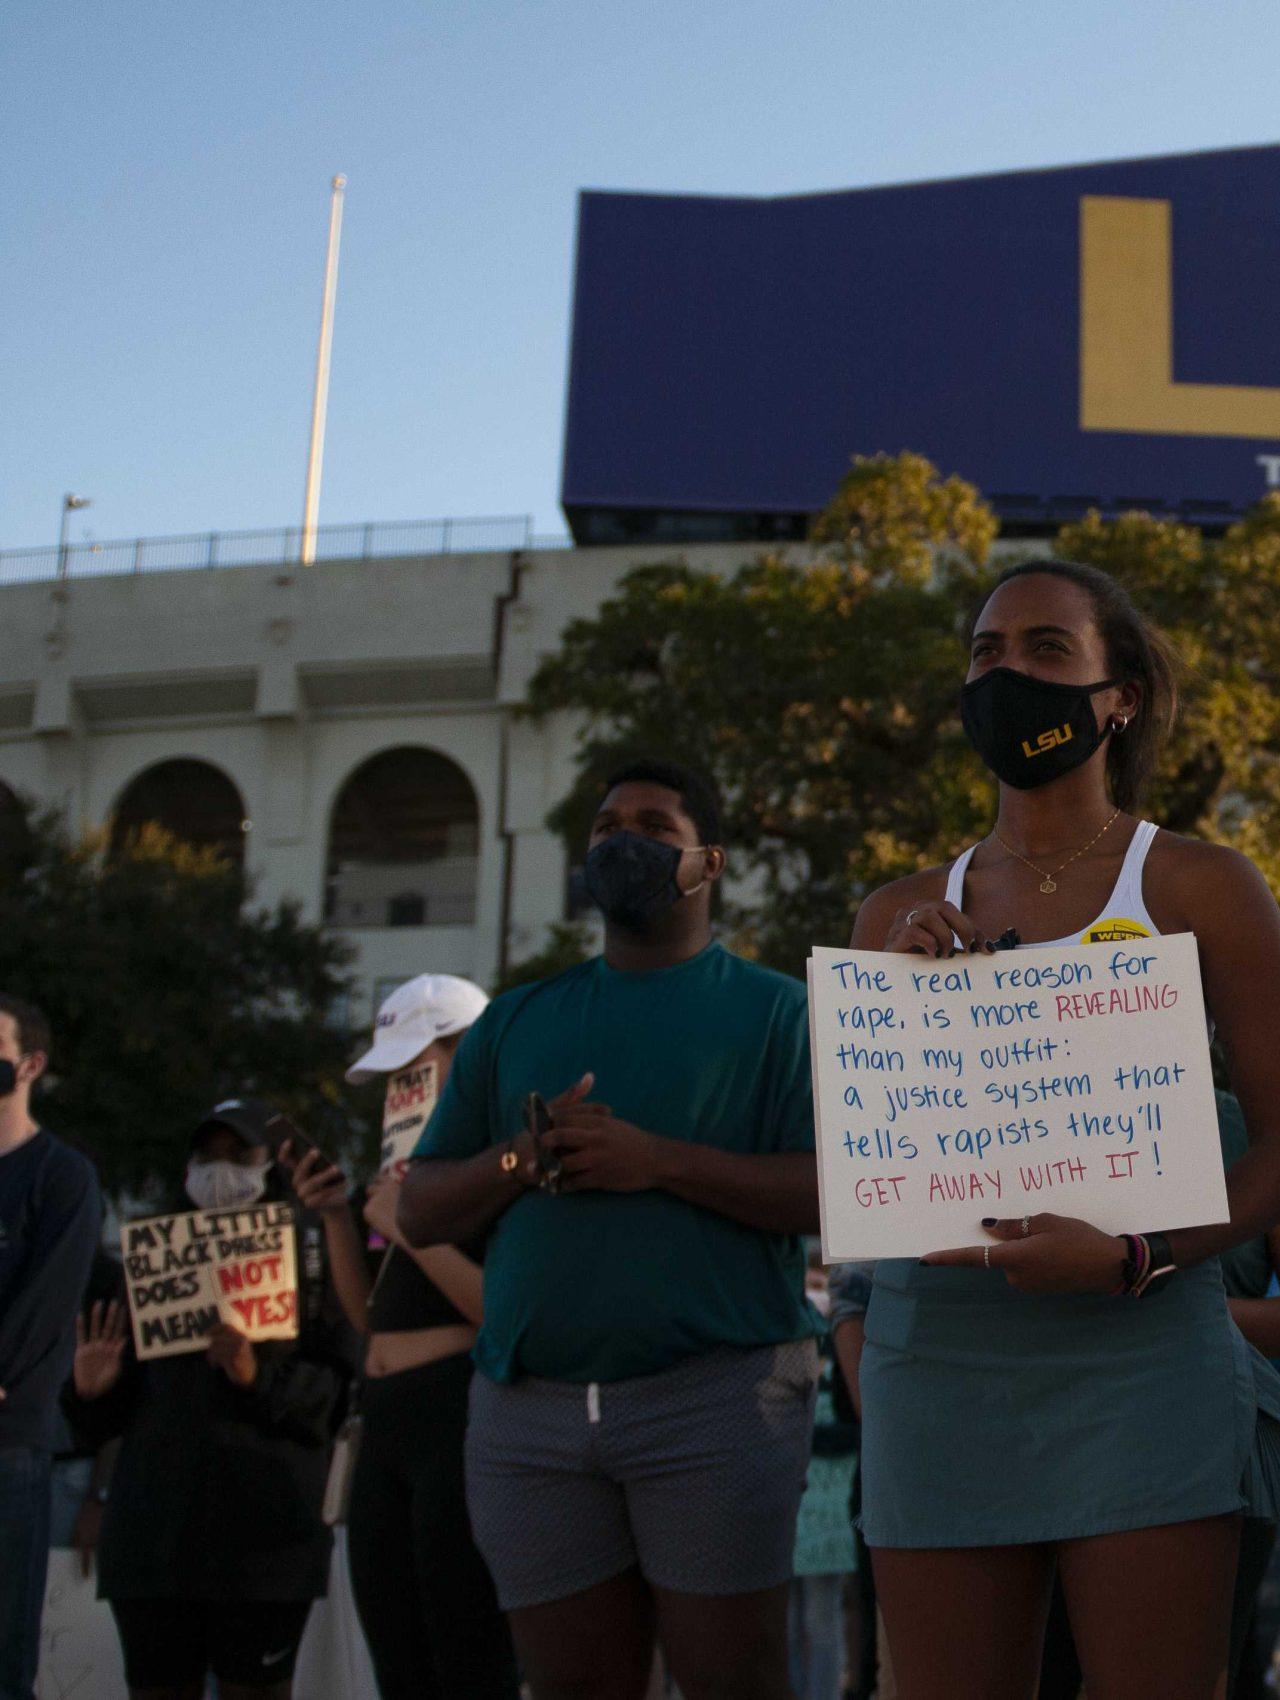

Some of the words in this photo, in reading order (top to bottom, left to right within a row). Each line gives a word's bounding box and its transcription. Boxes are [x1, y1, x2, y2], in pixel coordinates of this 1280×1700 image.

[1022, 722, 1073, 758] LSU
[831, 961, 893, 993] The
[911, 968, 973, 994] real
[994, 961, 1093, 990] reason
[1108, 951, 1159, 980] for
[922, 1004, 952, 1030] is
[970, 1000, 1042, 1027] more
[1055, 983, 1179, 1023] REVEALING
[836, 1042, 905, 1073] than
[923, 1048, 963, 1077] my
[843, 1086, 864, 1111] a
[885, 1083, 968, 1122] justice
[984, 1073, 1093, 1109] system
[1113, 1060, 1187, 1092] that
[842, 1129, 919, 1161] tells
[936, 1117, 1050, 1158] rapists
[1065, 1102, 1163, 1145] they'll
[855, 1176, 907, 1209] GET
[928, 1172, 1002, 1204] AWAY
[1019, 1156, 1088, 1192] WITH
[128, 1219, 176, 1252] MY
[187, 1205, 295, 1240] LITTLE
[127, 1241, 213, 1281] BLACK
[215, 1230, 283, 1258] DRESS
[132, 1271, 200, 1310] DOES
[217, 1256, 282, 1296] NOT
[140, 1303, 221, 1348] MEAN
